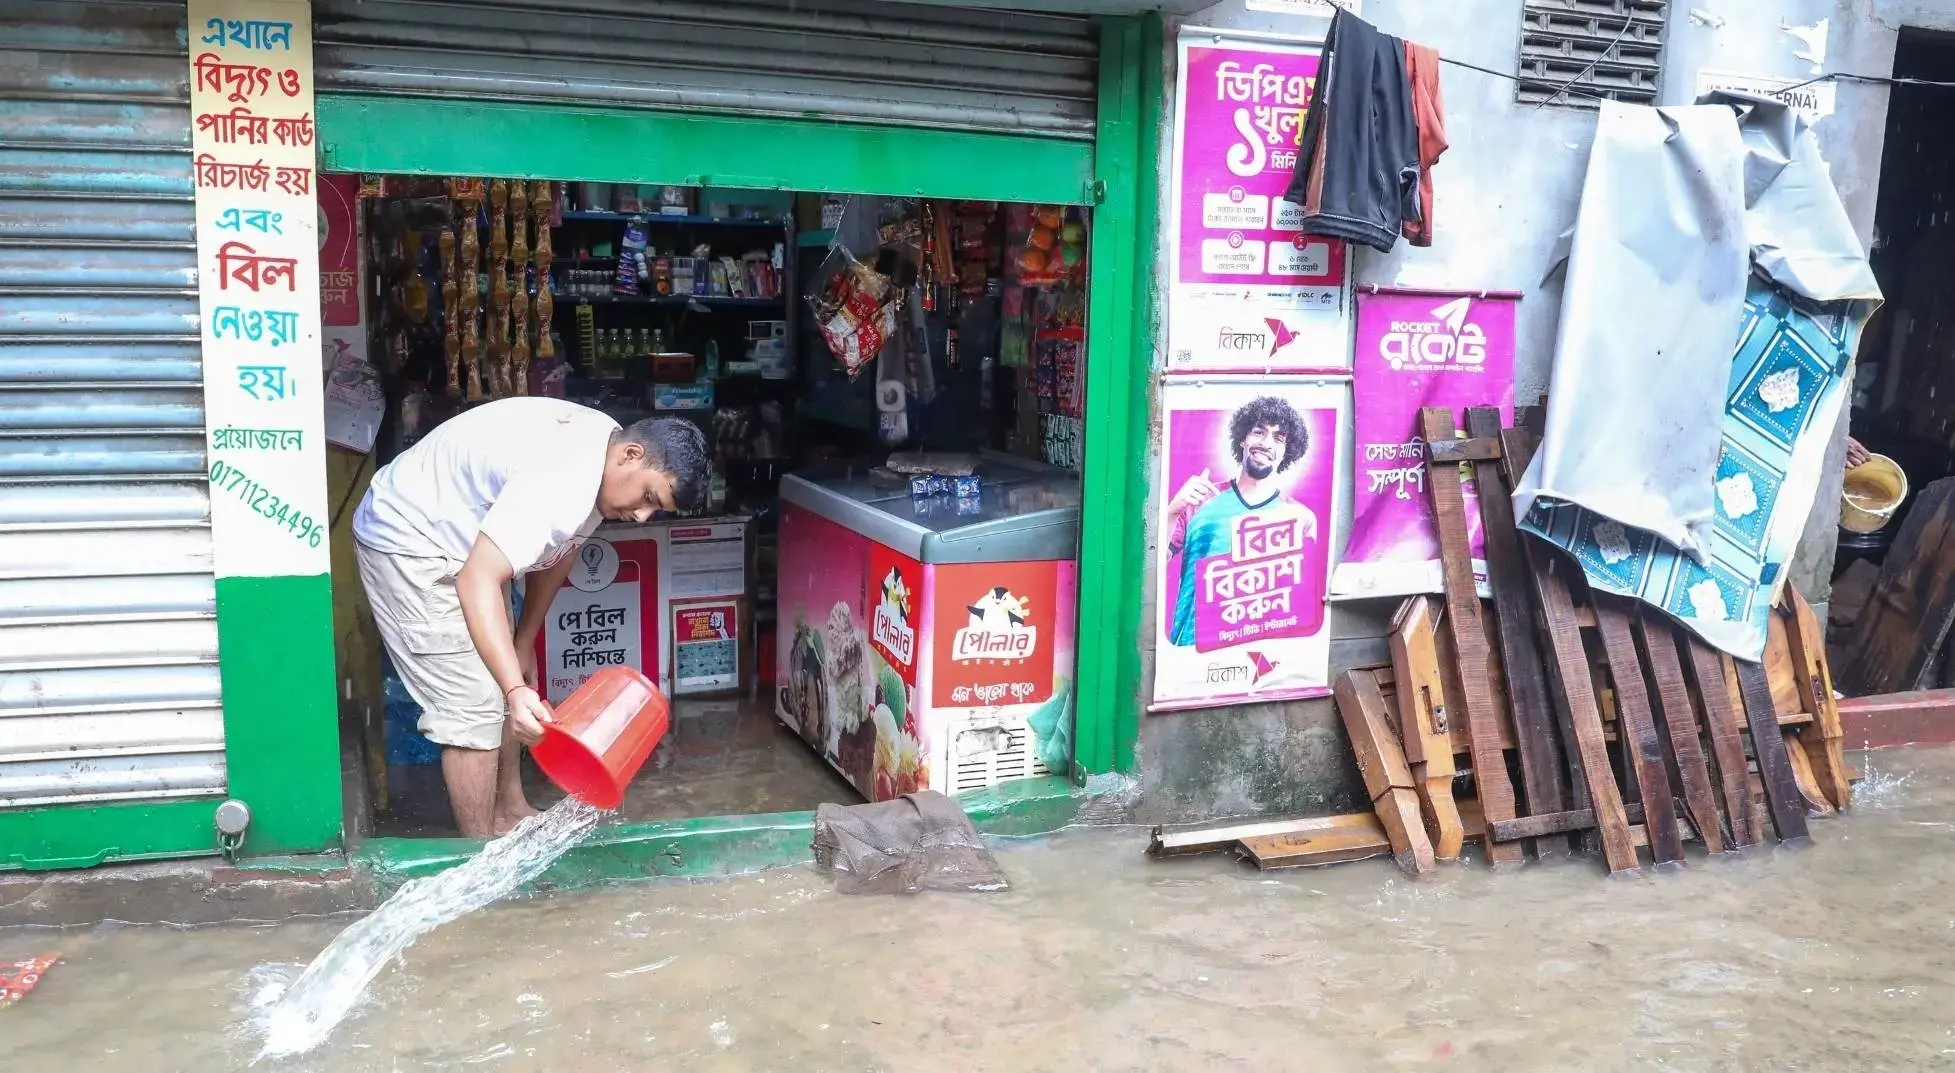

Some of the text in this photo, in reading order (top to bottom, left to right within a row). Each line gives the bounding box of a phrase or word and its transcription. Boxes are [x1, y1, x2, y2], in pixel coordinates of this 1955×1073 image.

[201, 18, 293, 50] এখানে
[193, 52, 300, 103] বিদ্যুৎ ও
[196, 106, 314, 147] পানির কার্ড
[1226, 108, 1298, 177] ১ মিনি
[1255, 105, 1308, 146] খুলু
[194, 153, 311, 196] রিচার্জ হয়
[215, 208, 283, 235] এবং
[215, 241, 298, 292] বিল
[320, 266, 354, 288] চার্জ
[320, 289, 347, 305] রুন
[212, 306, 300, 347] নেওয়া
[1218, 326, 1266, 350] বিকাশ
[1391, 321, 1440, 333] ROCKET
[1380, 323, 1487, 371] রকেট
[212, 425, 303, 450] প্রয়োজনে
[1366, 461, 1425, 500] সম্পূর্ণ
[210, 460, 325, 548] 01711234496
[1236, 516, 1297, 558] বিল
[1203, 553, 1304, 603] বিকাশ
[559, 604, 626, 630] পে বিল
[1220, 586, 1292, 624] করুন
[570, 628, 617, 647] করুন
[877, 610, 911, 662] পোলার
[959, 631, 1030, 656] পোলার
[562, 647, 626, 669] নিশ্চিন্তে
[1207, 662, 1248, 683] বিকাশ
